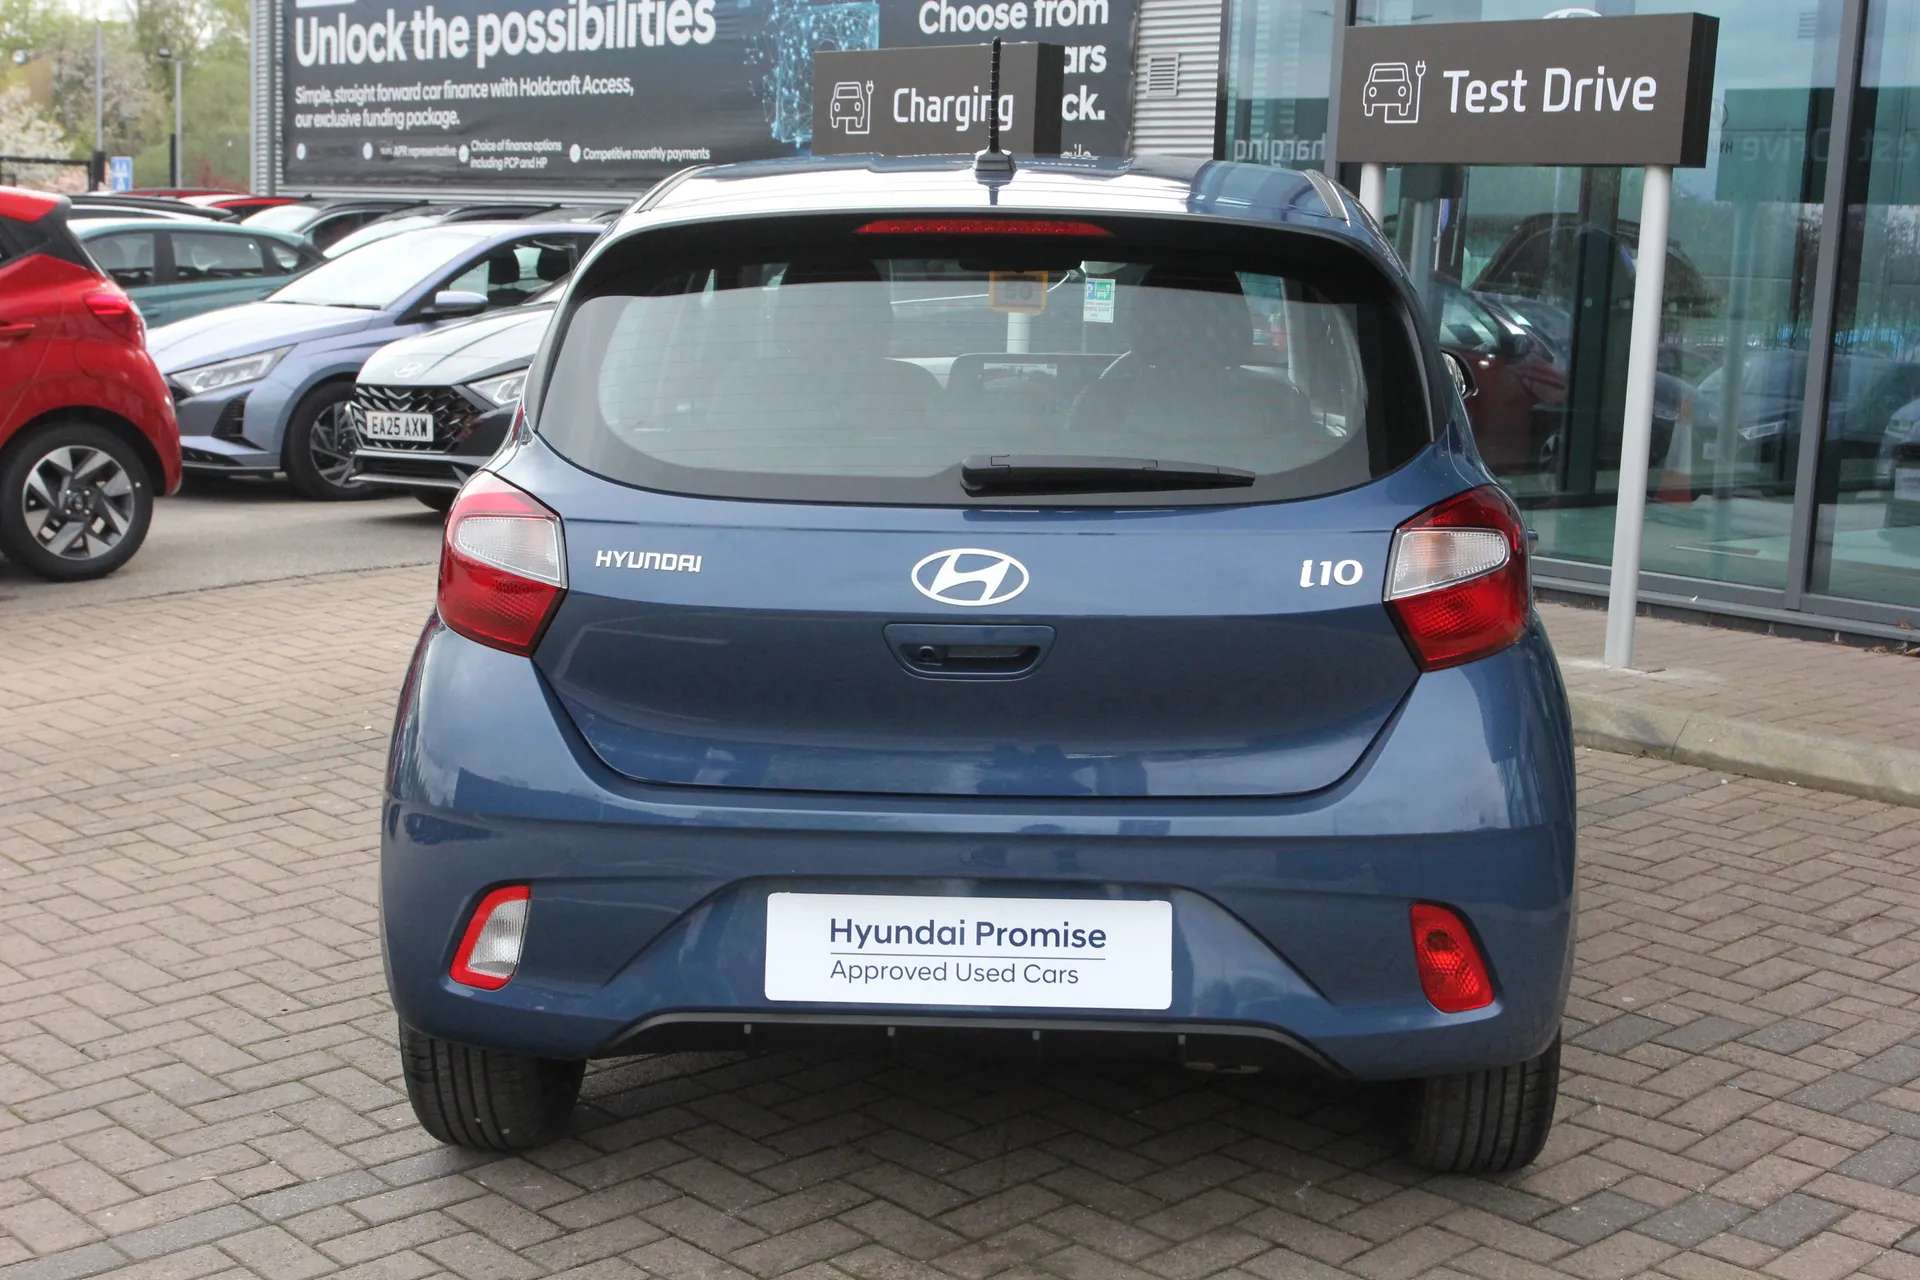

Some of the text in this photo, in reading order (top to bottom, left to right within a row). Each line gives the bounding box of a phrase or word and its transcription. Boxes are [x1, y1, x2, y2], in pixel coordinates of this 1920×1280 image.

[919, 0, 1109, 34] Choose from
[296, 0, 717, 69] Unlock the possibilities
[1063, 44, 1107, 74] ars
[295, 74, 634, 107] Simple, straight forward car finance with Holdcroft Access,
[1061, 85, 1106, 121] ck.
[1443, 65, 1656, 113] Test Drive
[295, 107, 460, 130] our exclusive funding package.
[893, 86, 1014, 131] Charging
[583, 146, 710, 162] Competitive monthly payments
[372, 416, 428, 437] EA25 AXW
[595, 550, 702, 572] HYUNDAI
[829, 918, 1107, 949] Hyundai Promise
[829, 960, 1080, 985] Approved Used Cars
